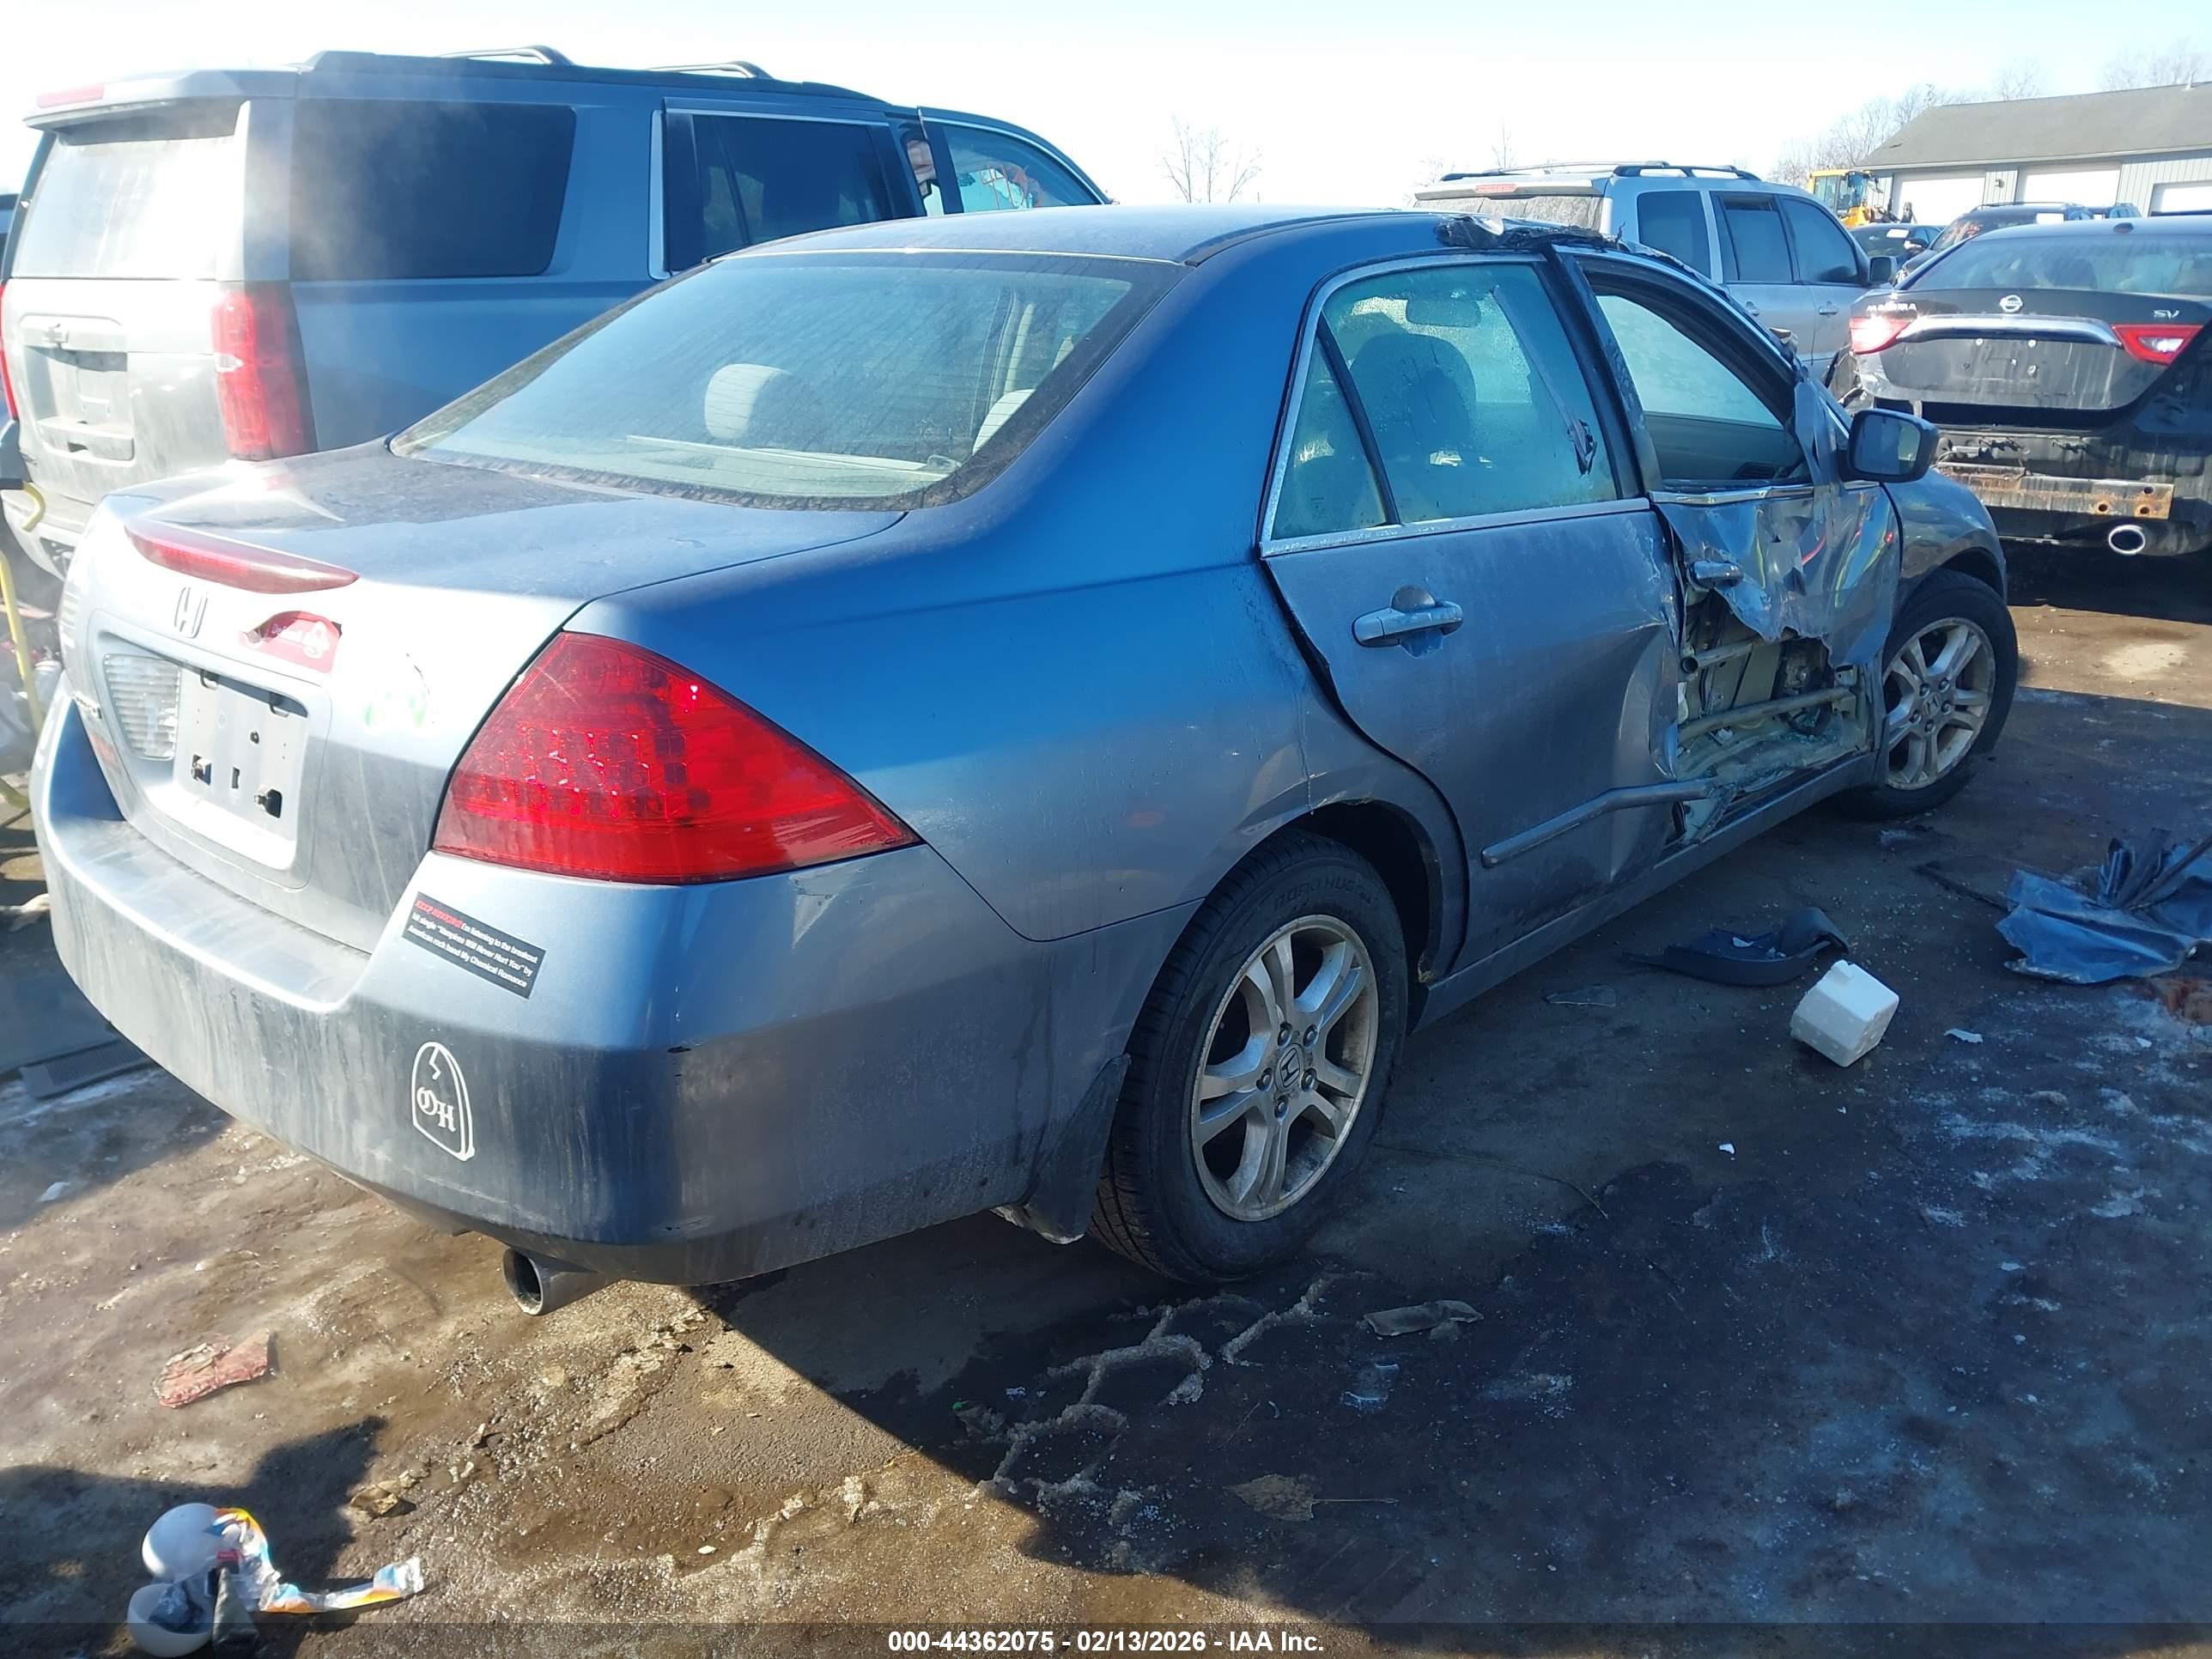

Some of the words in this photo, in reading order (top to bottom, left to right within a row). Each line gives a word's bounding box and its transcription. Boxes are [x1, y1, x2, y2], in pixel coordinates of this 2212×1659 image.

[2153, 309, 2179, 319] SV
[494, 954, 508, 963] Hurt
[471, 957, 498, 974] Chemical
[498, 969, 526, 987] Romance
